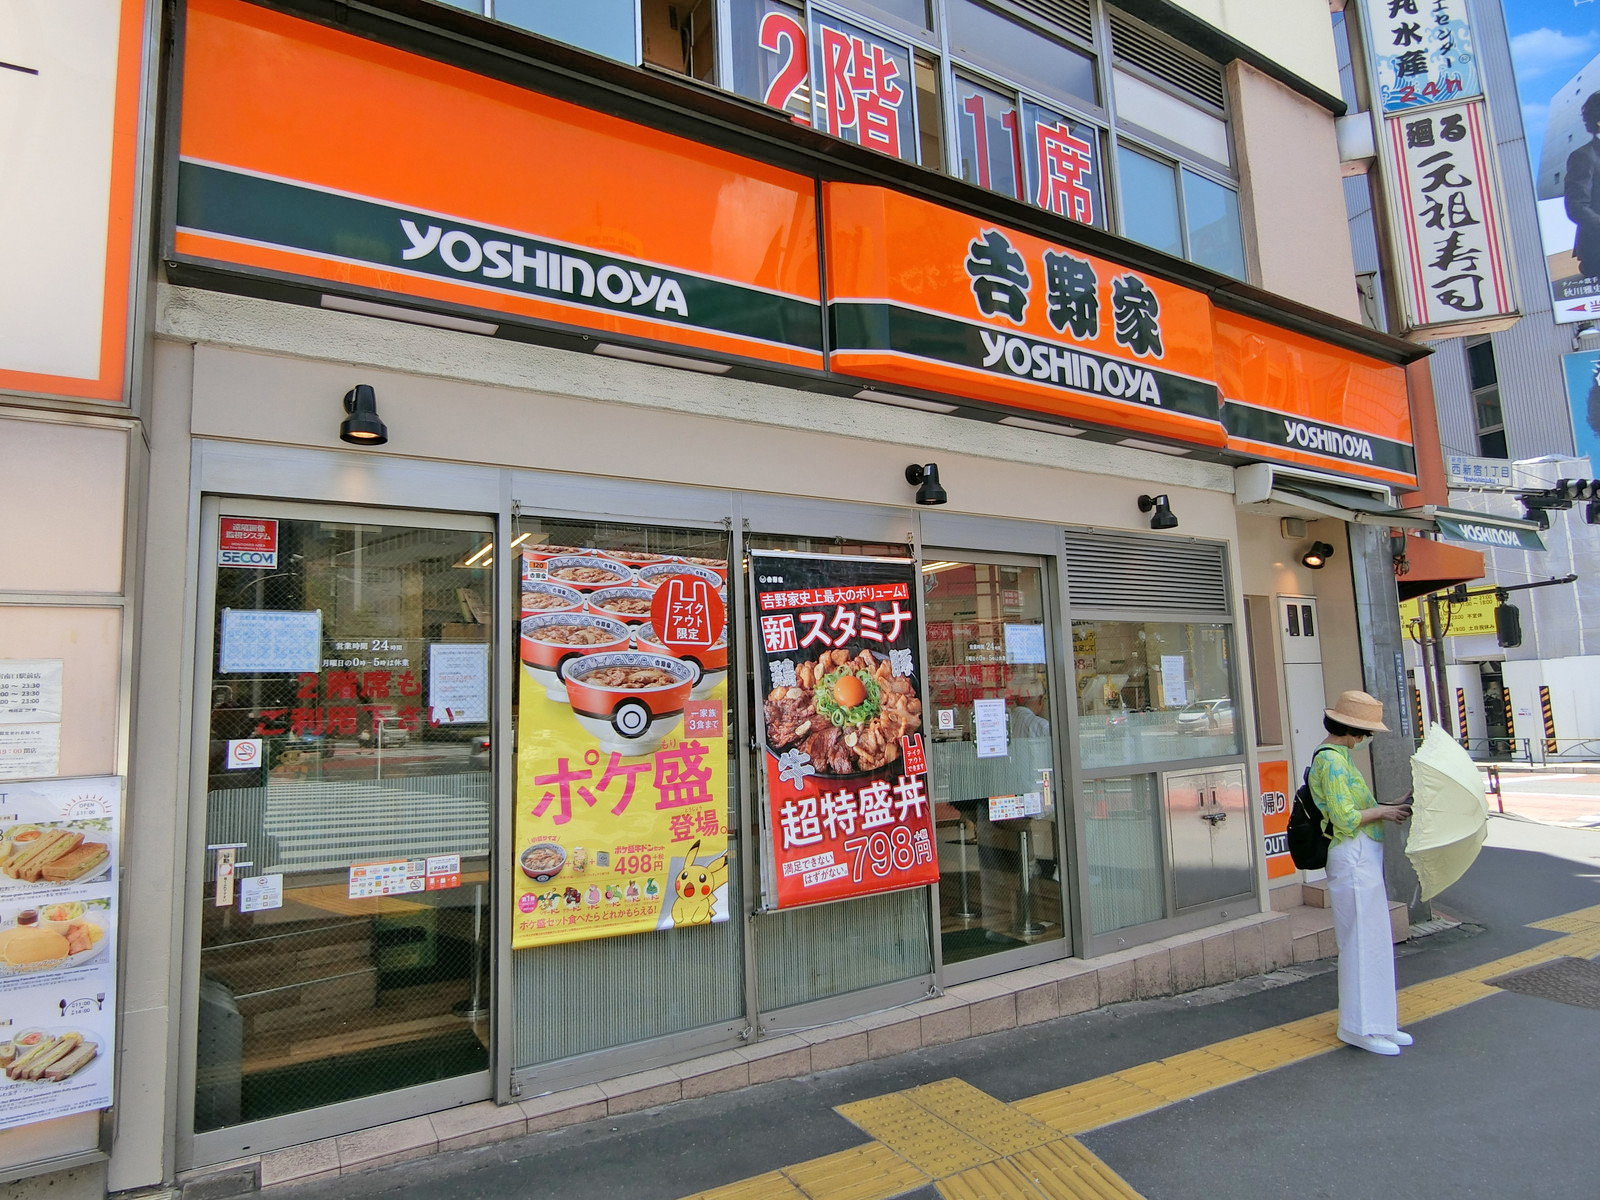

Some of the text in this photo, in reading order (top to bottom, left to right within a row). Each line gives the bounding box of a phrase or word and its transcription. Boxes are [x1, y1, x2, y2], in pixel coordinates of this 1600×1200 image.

[1417, 151, 1484, 312] 元祖寿司
[400, 218, 688, 317] YOSHINOYA
[978, 330, 1161, 406] YOSHINOYA
[1284, 420, 1373, 461] YOSHINOYA
[1451, 463, 1510, 478] 西新宿1丁目
[1458, 524, 1521, 547] YOSHINOYA
[222, 552, 273, 564] SECOM
[672, 601, 703, 614] テイク
[672, 615, 703, 628] アウト
[764, 616, 795, 650] 新
[800, 602, 912, 648] スタミナ
[676, 627, 700, 640] 限定
[336, 642, 368, 651] 営業時間
[296, 670, 423, 700] 2階席も
[256, 705, 455, 736] ご利用下さい
[690, 708, 717, 718] 一家族
[689, 720, 719, 730] 3食まで
[660, 739, 676, 749] もり
[907, 749, 921, 757] テイク
[778, 748, 816, 790] 牛
[907, 763, 925, 772] できます
[908, 757, 922, 765] アウト
[531, 739, 713, 825] ポケ盛
[781, 774, 927, 849] 超特盛丼
[668, 808, 728, 843] 登場。
[1264, 836, 1285, 854] OUT
[784, 854, 834, 874] 満足できない
